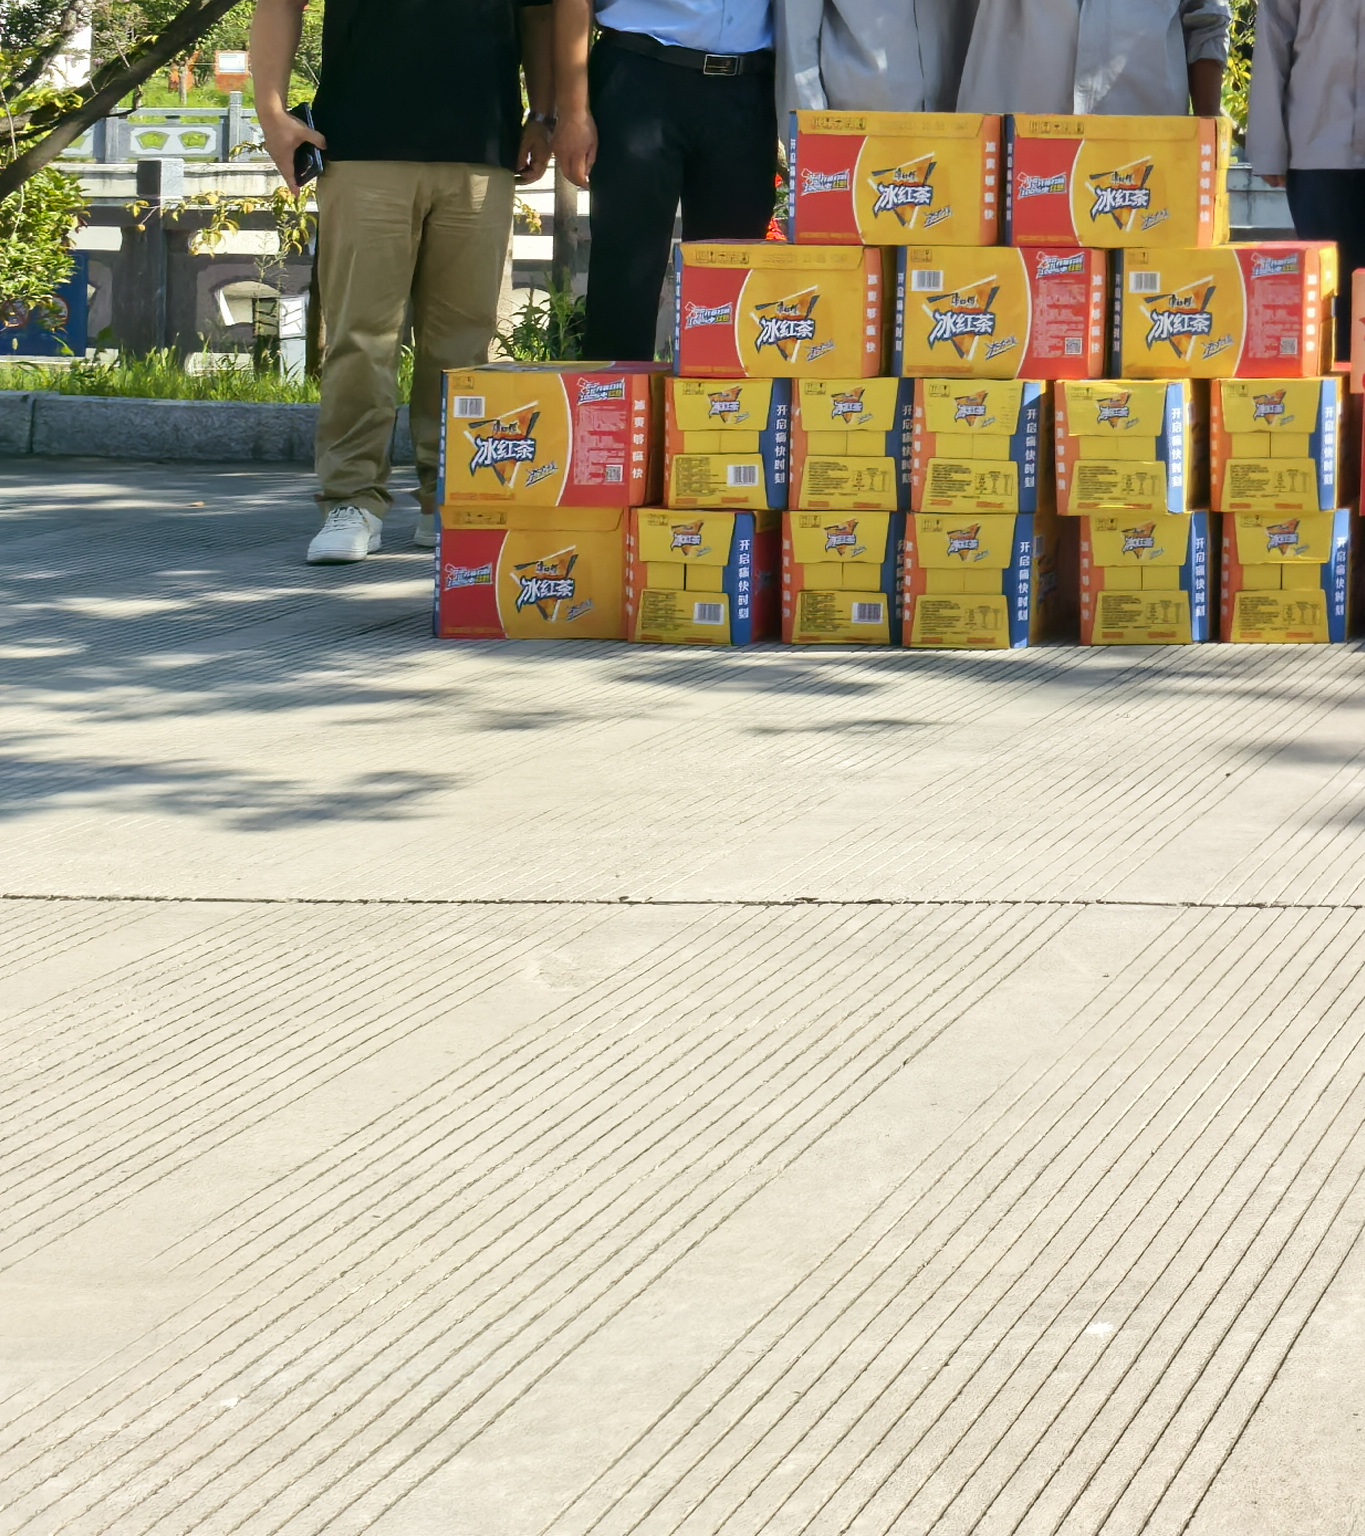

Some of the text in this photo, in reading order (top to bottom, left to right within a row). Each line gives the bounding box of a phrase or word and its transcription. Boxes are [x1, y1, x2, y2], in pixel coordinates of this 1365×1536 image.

[875, 185, 932, 214] 冰红茶
[1091, 188, 1150, 217] 冰红茶
[756, 318, 815, 349] 冰红茶
[929, 311, 995, 346] 冰红茶
[1147, 311, 1212, 347] 冰红茶
[471, 437, 535, 473] 冰红茶
[1024, 408, 1038, 488] 开启痛快时刻
[515, 577, 575, 609] 冰红茶
[738, 539, 751, 619] 开启痛快时刻
[1017, 541, 1031, 622] 开启痛快时刻
